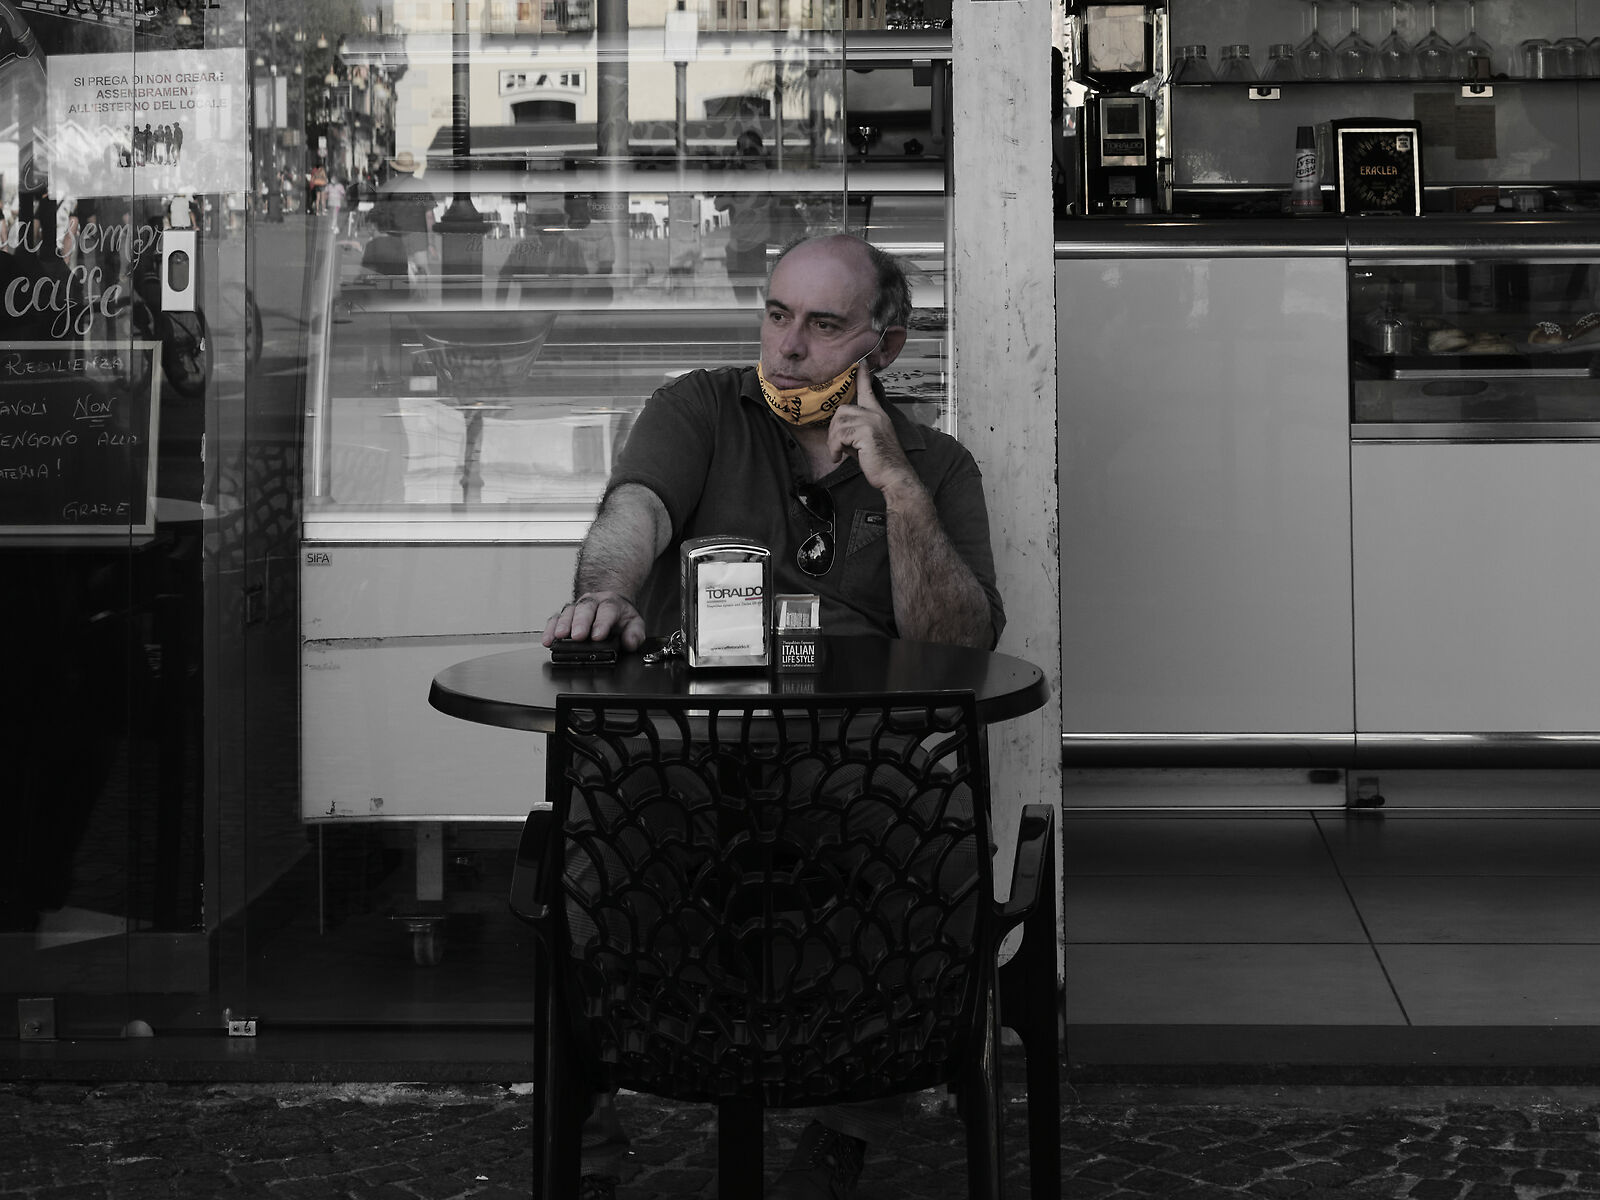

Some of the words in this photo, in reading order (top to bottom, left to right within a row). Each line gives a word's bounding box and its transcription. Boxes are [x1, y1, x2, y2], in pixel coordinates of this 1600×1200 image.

[74, 77, 86, 87] SI
[88, 75, 129, 87] PREGA
[132, 75, 144, 86] DI
[146, 73, 173, 85] NON
[175, 71, 224, 84] CREARE
[68, 102, 150, 115] ALL'ESTERNO
[153, 100, 177, 112] DEL
[1360, 164, 1398, 176] ERACLEA
[55, 220, 163, 275] sempr
[62, 501, 131, 522] GRAZIE
[306, 553, 330, 563] SIFA
[706, 586, 763, 599] TORALDO
[782, 644, 815, 656] ITALIAN
